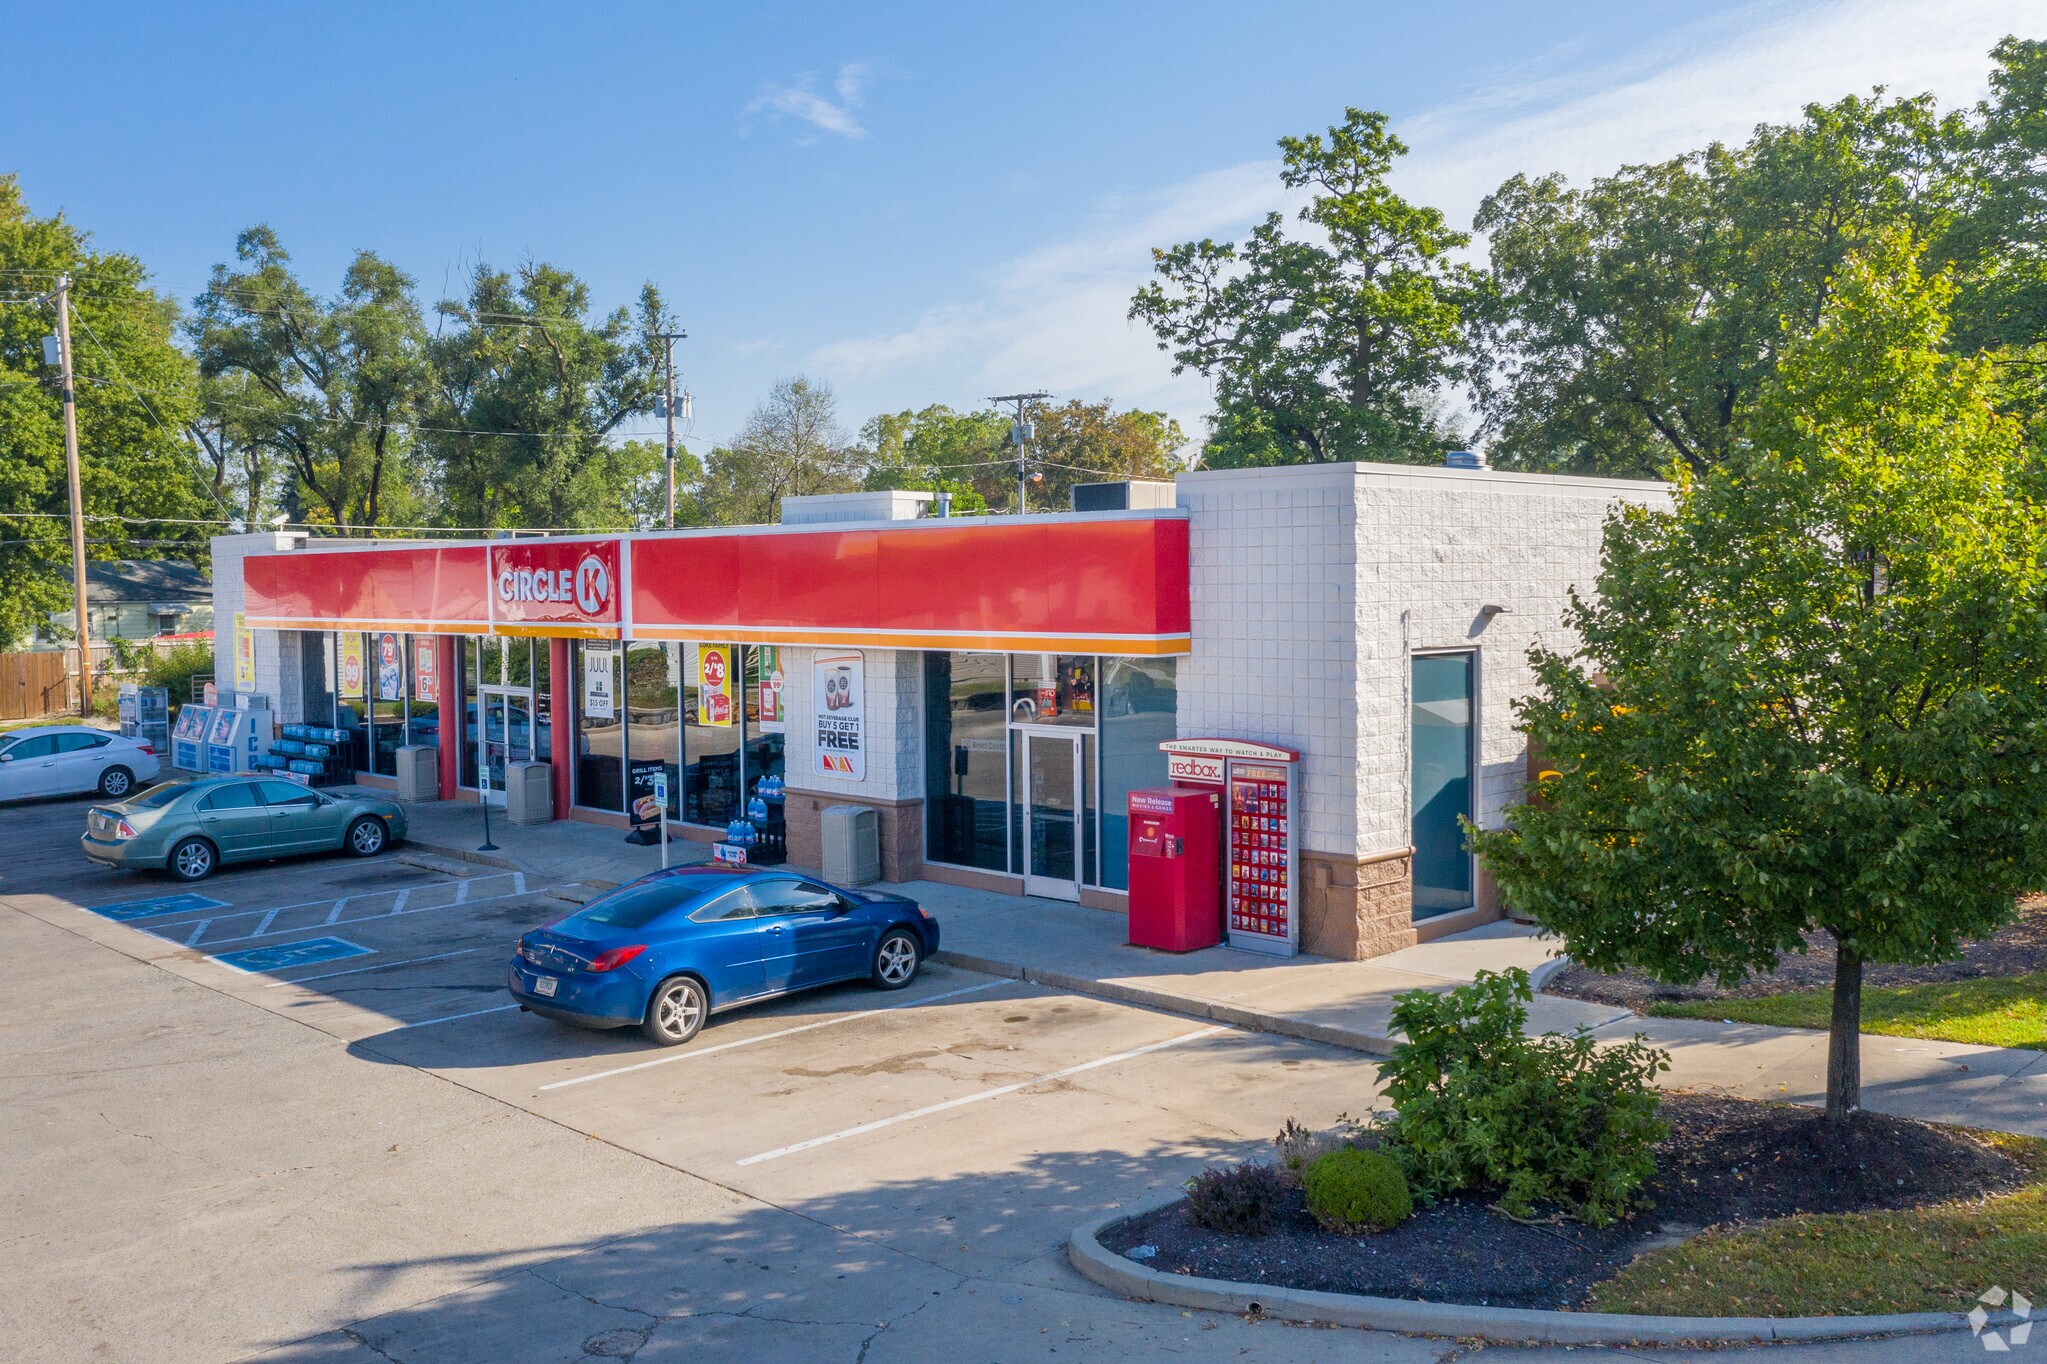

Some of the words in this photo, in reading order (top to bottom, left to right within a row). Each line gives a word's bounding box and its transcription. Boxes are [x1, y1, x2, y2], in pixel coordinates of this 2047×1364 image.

[499, 569, 573, 602] CIRCLE
[589, 657, 609, 674] JUUL
[704, 662, 724, 679] 2/$8
[818, 720, 833, 729] BUY
[839, 722, 854, 731] GET
[818, 729, 859, 750] FREE
[1247, 770, 1265, 778] FREE
[1132, 796, 1146, 804] New
[1147, 798, 1172, 806] Release
